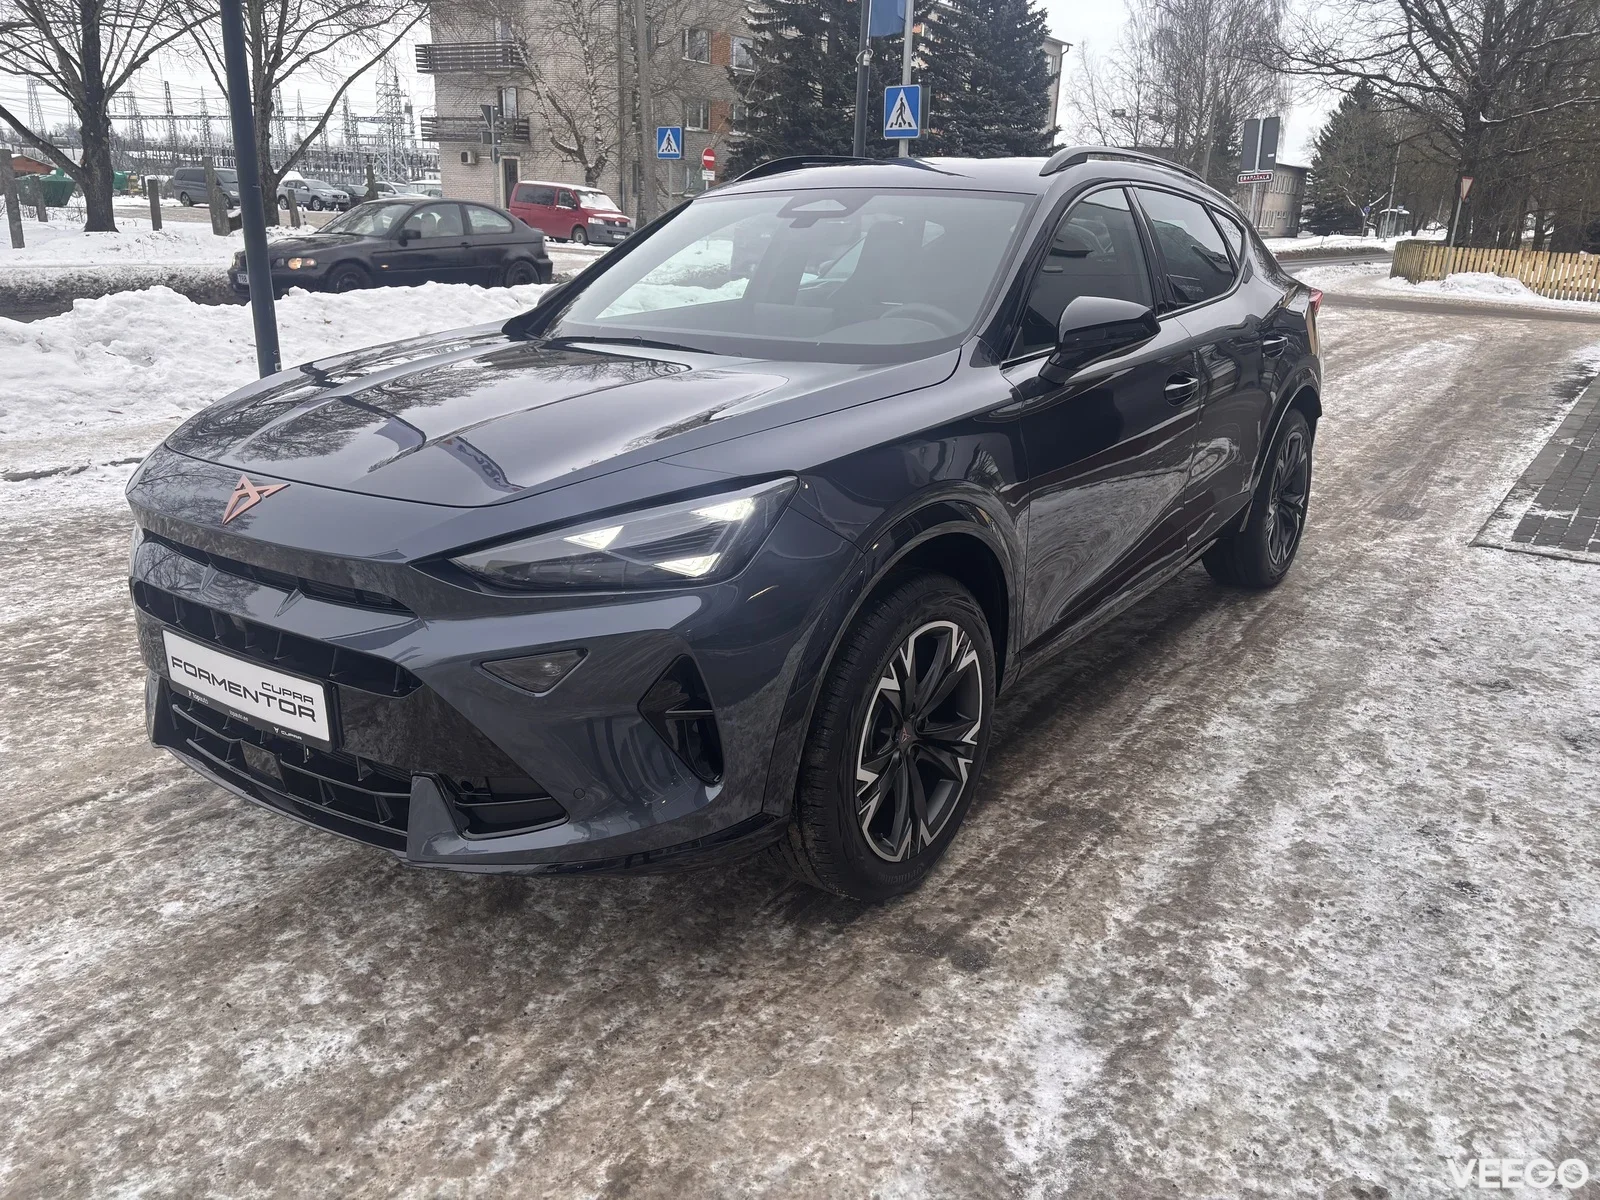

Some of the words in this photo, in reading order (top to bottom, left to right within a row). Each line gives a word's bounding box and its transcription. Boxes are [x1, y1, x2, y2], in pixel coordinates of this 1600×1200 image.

[171, 656, 317, 722] FORMENTOR
[261, 682, 314, 705] CUPRA
[280, 730, 303, 741] CUPRA
